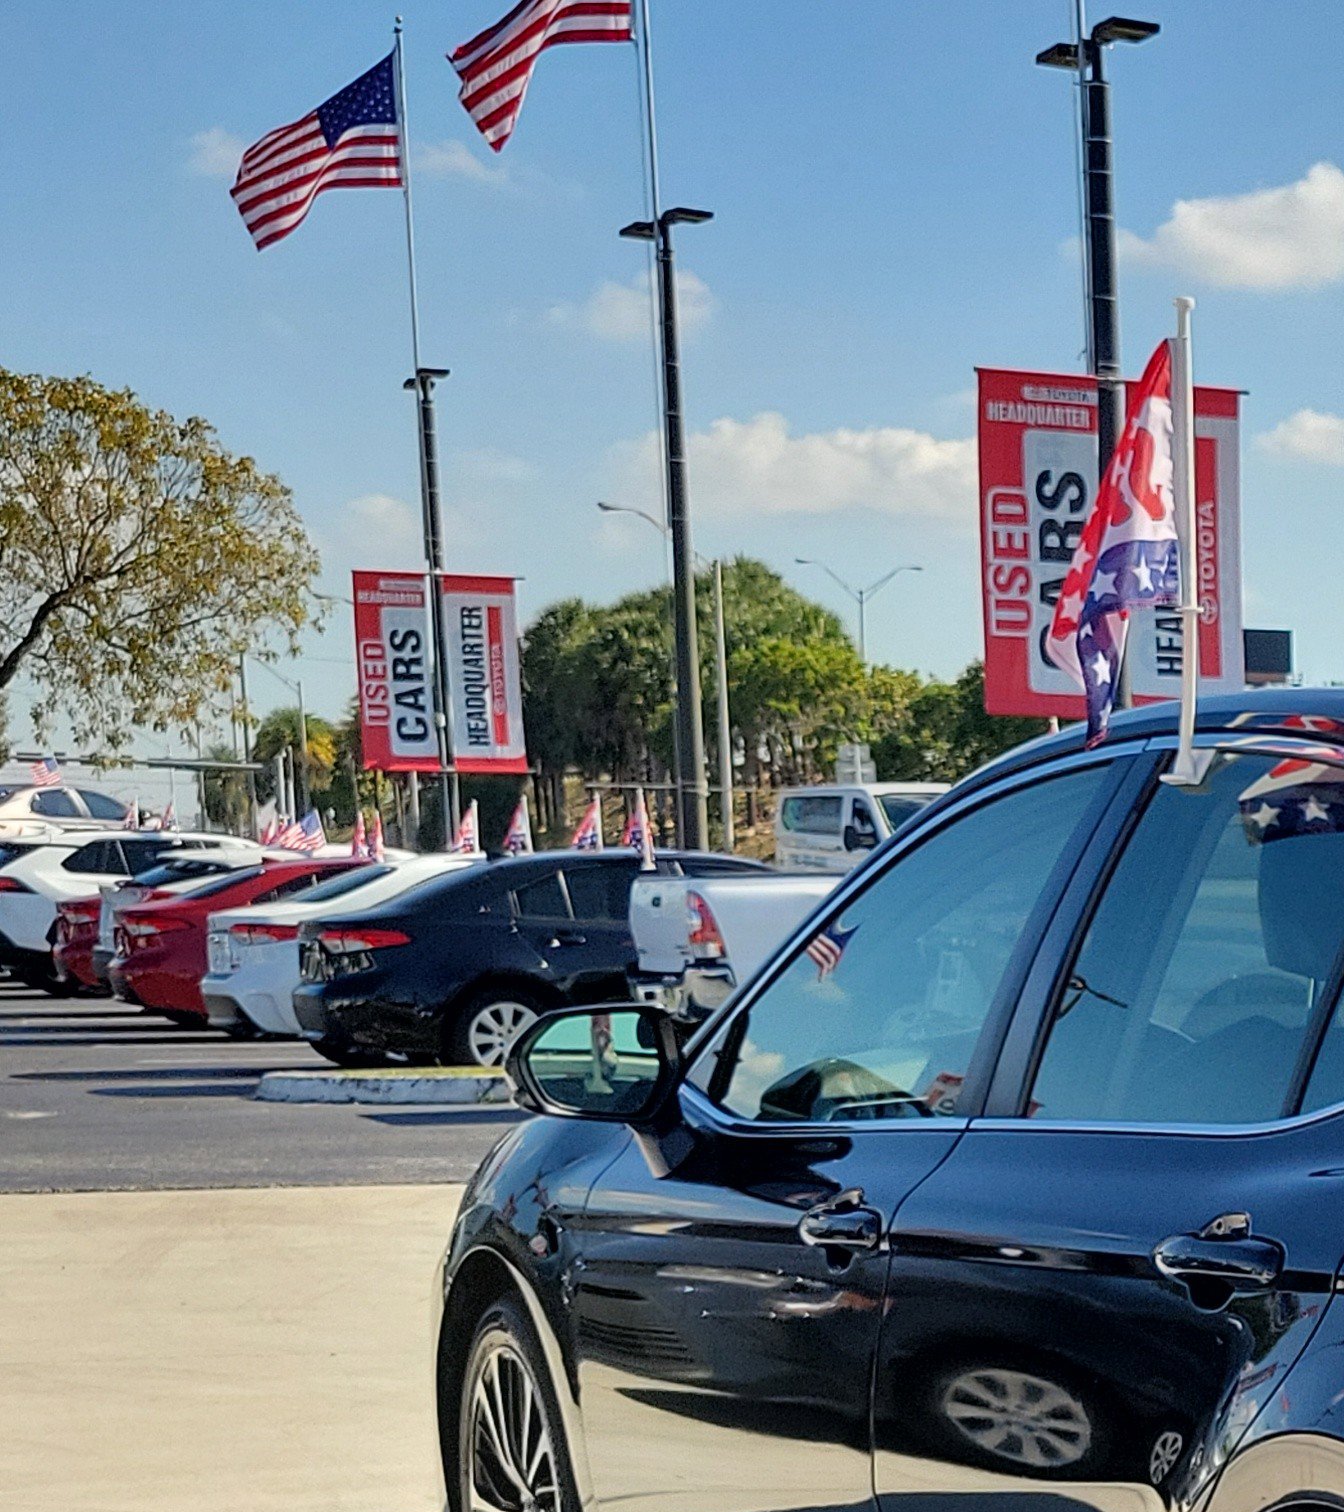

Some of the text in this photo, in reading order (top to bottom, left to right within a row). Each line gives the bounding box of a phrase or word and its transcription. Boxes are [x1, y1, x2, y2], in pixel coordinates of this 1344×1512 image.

[986, 401, 1090, 429] HEADQUARTER
[1046, 388, 1090, 402] TOYOTA
[993, 493, 1031, 631] USED
[1198, 501, 1216, 594] TOYOTA
[362, 642, 391, 724] USED
[390, 629, 429, 743] CARS
[460, 606, 491, 746] HEADQUARTER
